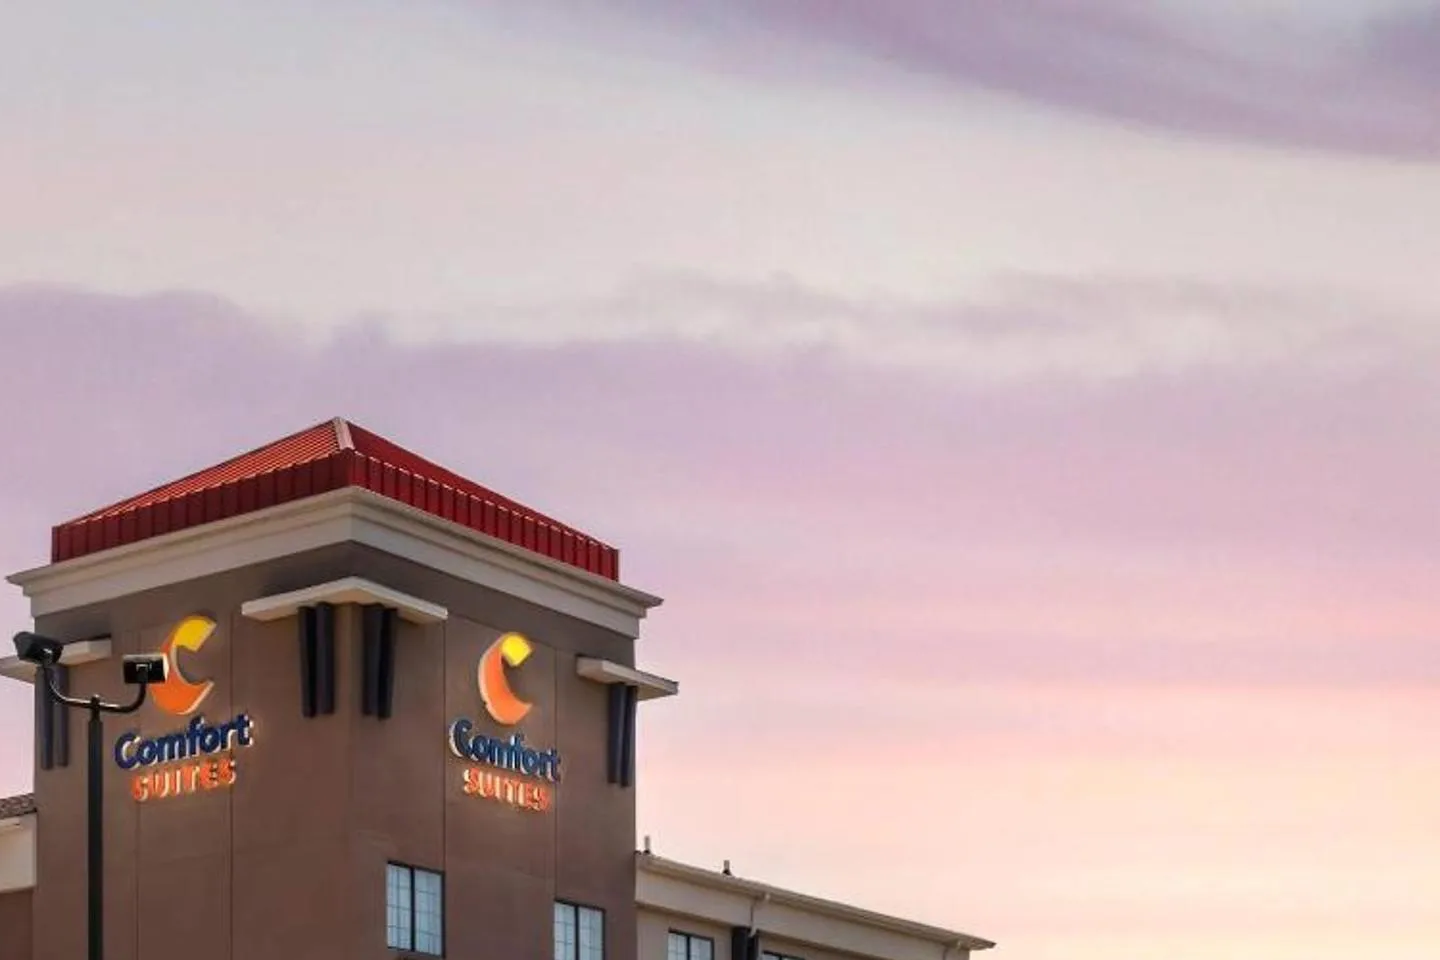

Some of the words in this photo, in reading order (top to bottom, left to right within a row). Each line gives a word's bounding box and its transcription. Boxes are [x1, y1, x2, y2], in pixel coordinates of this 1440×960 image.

[114, 712, 255, 771] Comfort
[448, 718, 561, 783] Comfort
[132, 756, 237, 801] SUITES
[463, 767, 552, 813] SUITES
